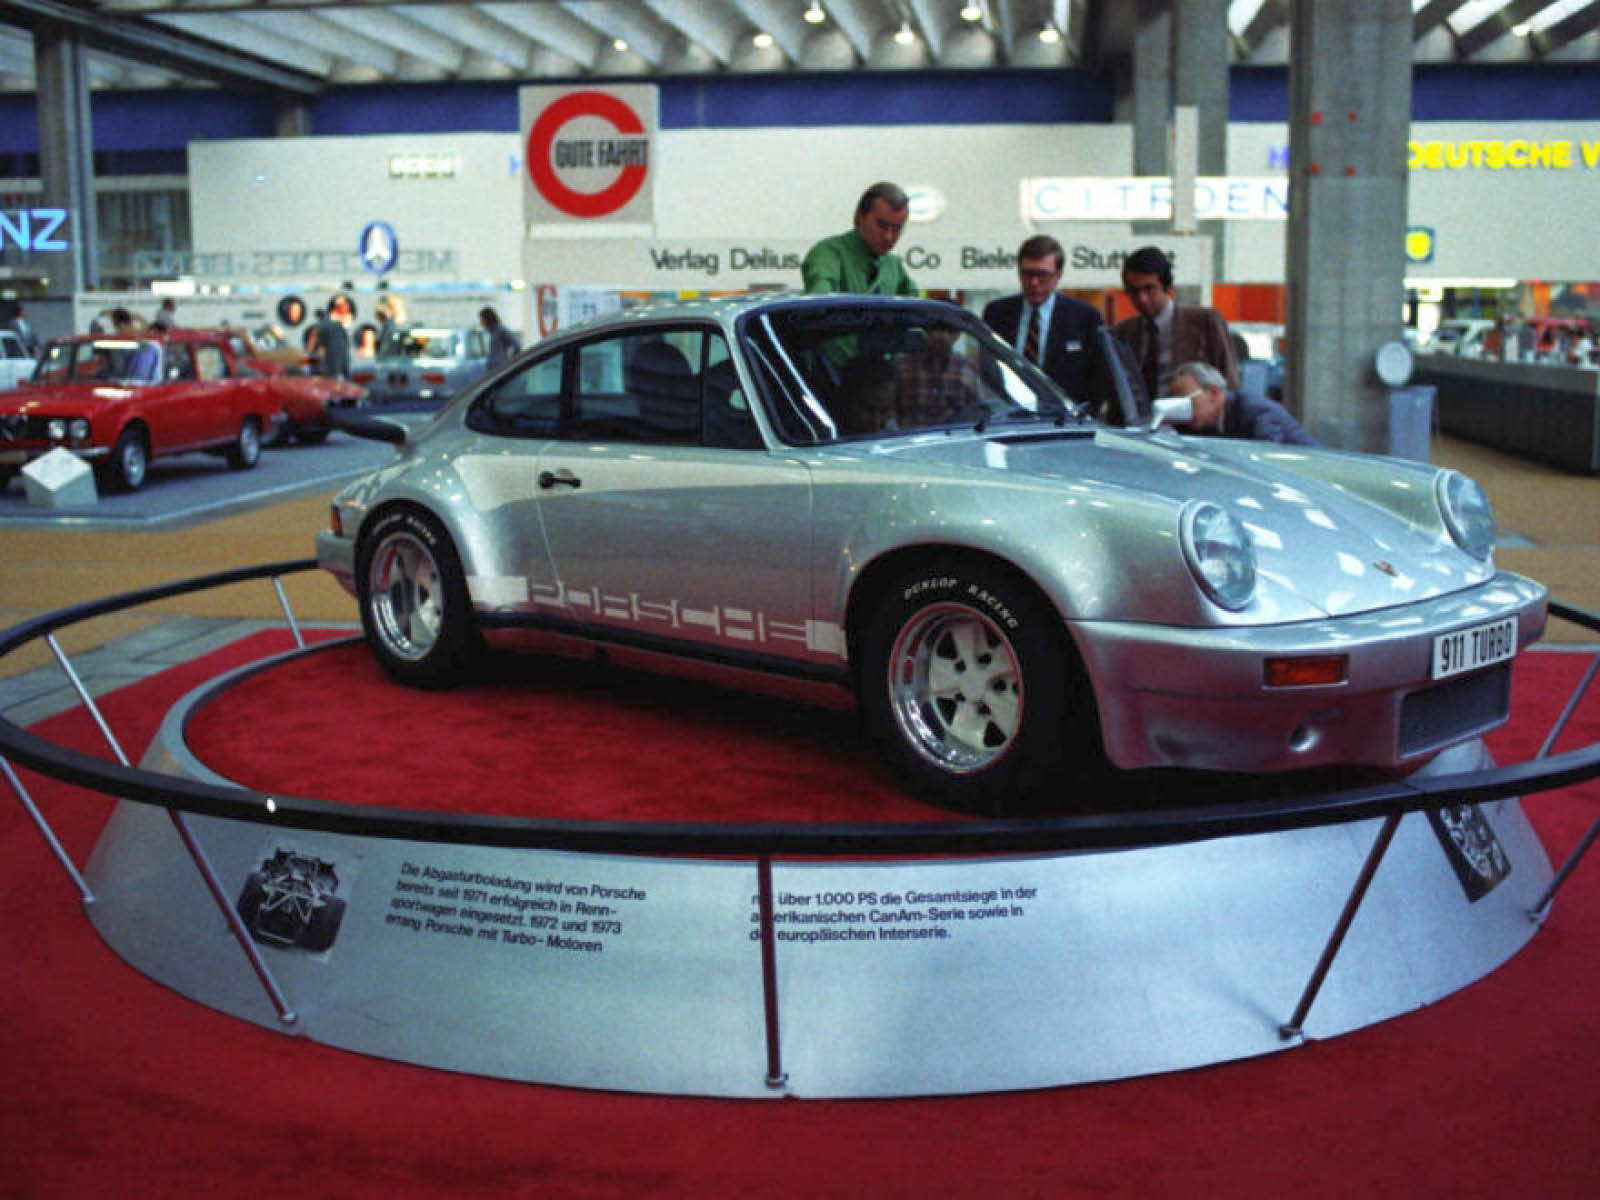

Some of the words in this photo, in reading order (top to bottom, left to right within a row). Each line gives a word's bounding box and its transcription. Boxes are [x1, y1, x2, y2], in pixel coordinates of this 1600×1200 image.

[555, 139, 594, 168] GUTE
[598, 139, 648, 167] FAHRT
[1408, 141, 1572, 168] DEUTSCHE
[650, 248, 718, 275] Verlag
[730, 247, 801, 269] Delius
[906, 247, 941, 269] Co
[962, 247, 1019, 269] Biele
[1441, 634, 1465, 672] 911
[1472, 621, 1513, 664] TURBO
[402, 862, 419, 876] Die
[423, 866, 531, 893] Abgasturboladung
[535, 881, 562, 895] wird
[566, 885, 587, 896] von
[591, 884, 646, 900] Porsche
[778, 891, 811, 905] über
[816, 891, 854, 905] 1.000
[857, 891, 877, 905] PS
[880, 891, 902, 904] die
[905, 889, 998, 904] Gesamtsiege
[1001, 887, 1013, 899] in
[1015, 885, 1037, 899] der
[397, 880, 433, 895] bereits
[439, 887, 458, 898] seit
[463, 888, 487, 902] 1971
[489, 894, 557, 912] erfolgreich
[560, 902, 571, 913] in
[576, 901, 616, 916] Renn-
[391, 898, 456, 917] sportwagen
[531, 915, 558, 930] 1972
[562, 920, 586, 932] und
[592, 920, 621, 934] 1973
[751, 909, 866, 924] aerikanischen
[868, 907, 965, 923] CanAm-Serie
[968, 905, 1008, 919] sowie
[1011, 904, 1023, 917] in
[387, 914, 421, 931] errang
[426, 918, 473, 936] Porsche
[478, 928, 497, 940] mit
[502, 929, 544, 945] Turbo-
[547, 935, 602, 951] Motoren
[777, 927, 876, 943] europäischen
[880, 926, 951, 940] Interserie.
